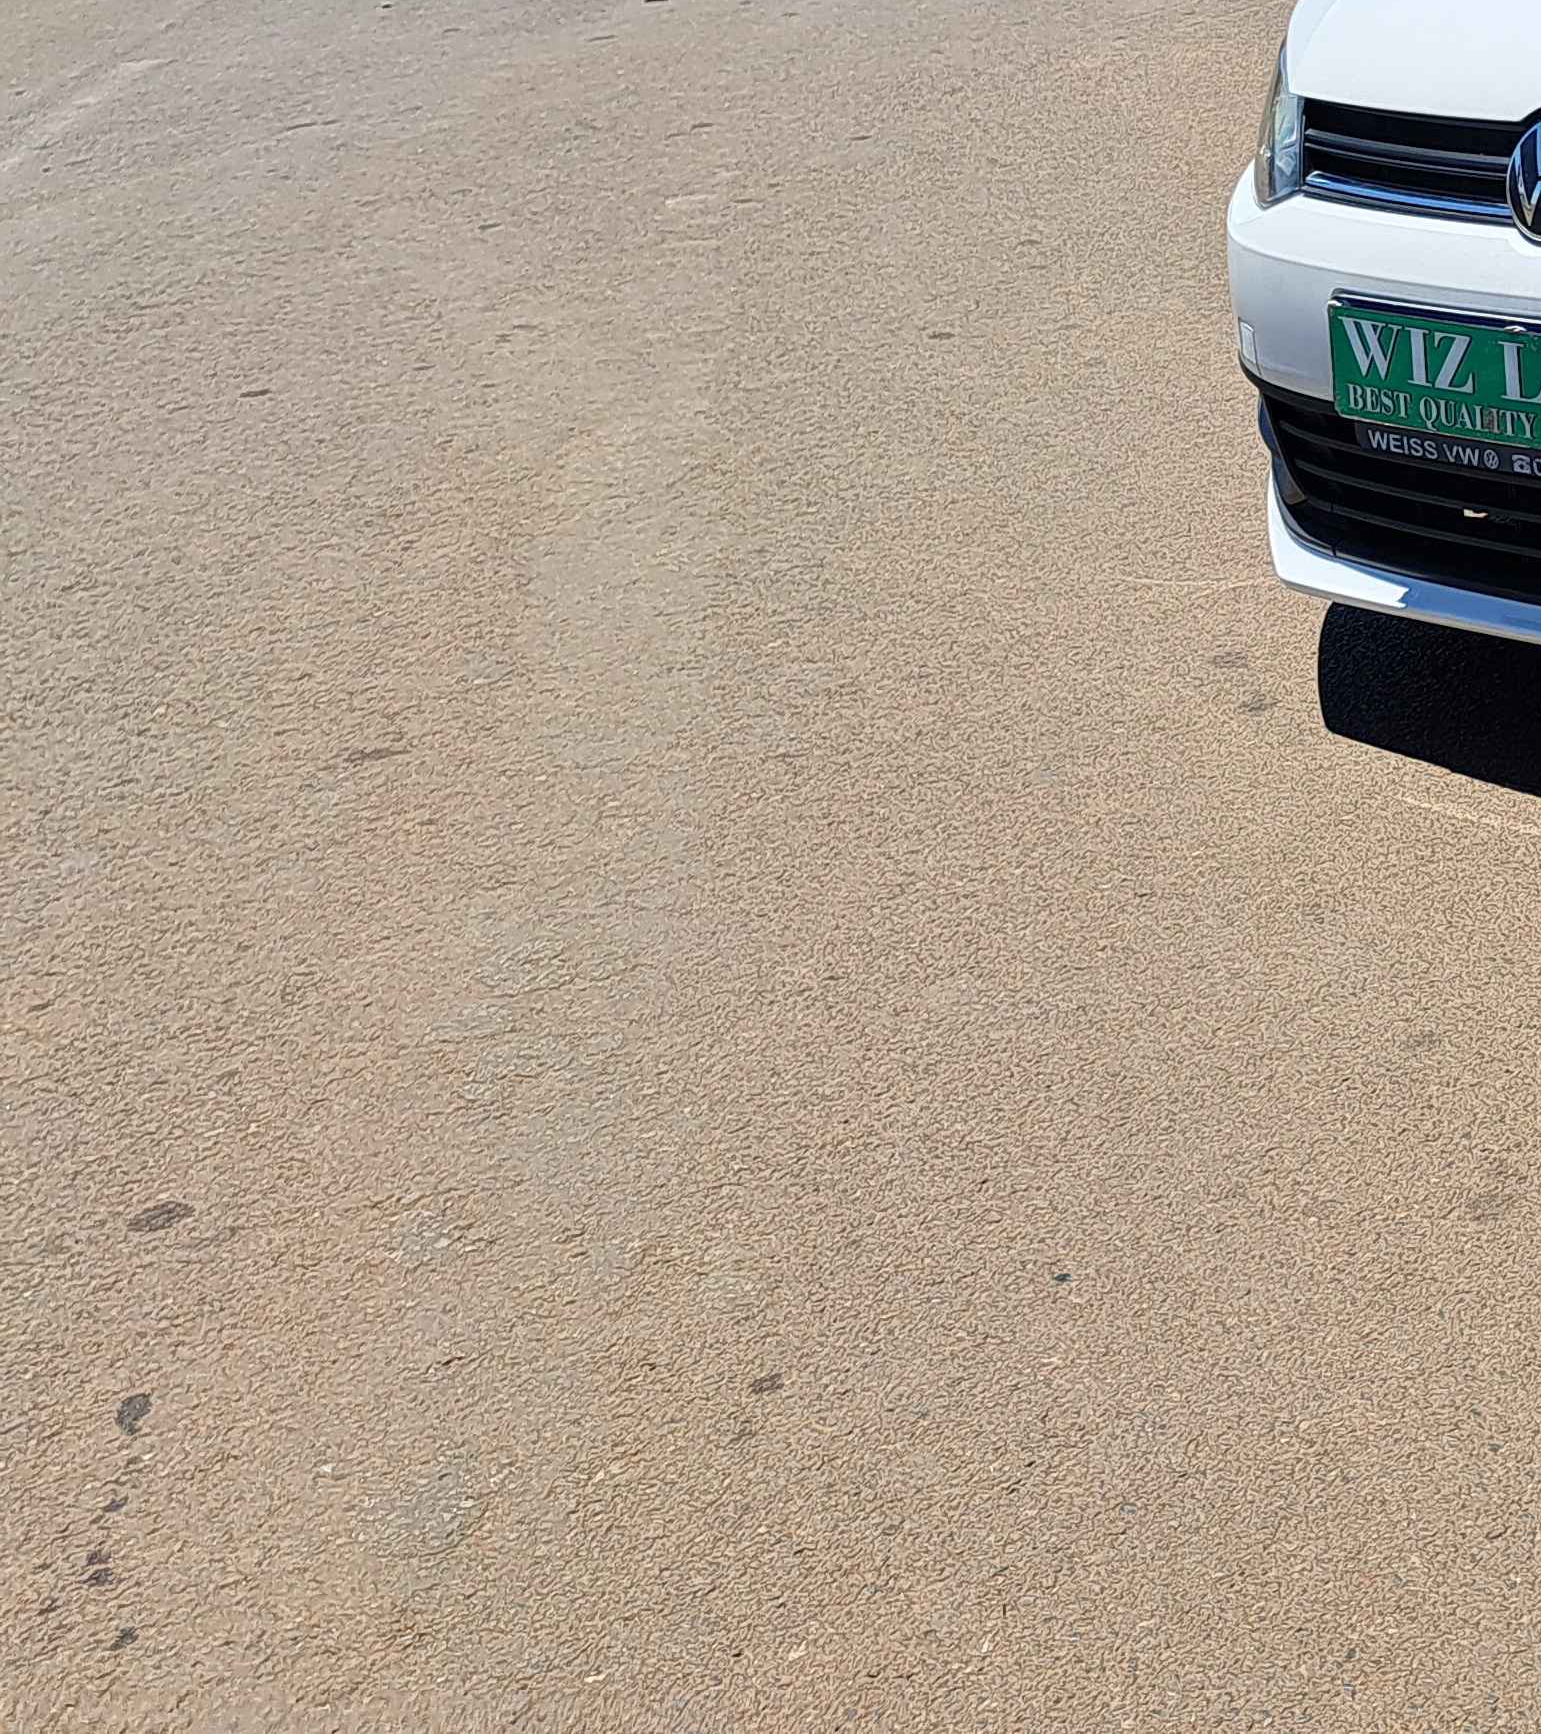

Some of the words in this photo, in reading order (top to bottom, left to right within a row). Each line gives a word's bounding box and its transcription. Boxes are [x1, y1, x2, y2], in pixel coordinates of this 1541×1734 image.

[1338, 315, 1475, 395] WIZ
[1347, 383, 1412, 419] BEST
[1419, 396, 1537, 437] QUALITY
[1367, 431, 1439, 462] WEISS
